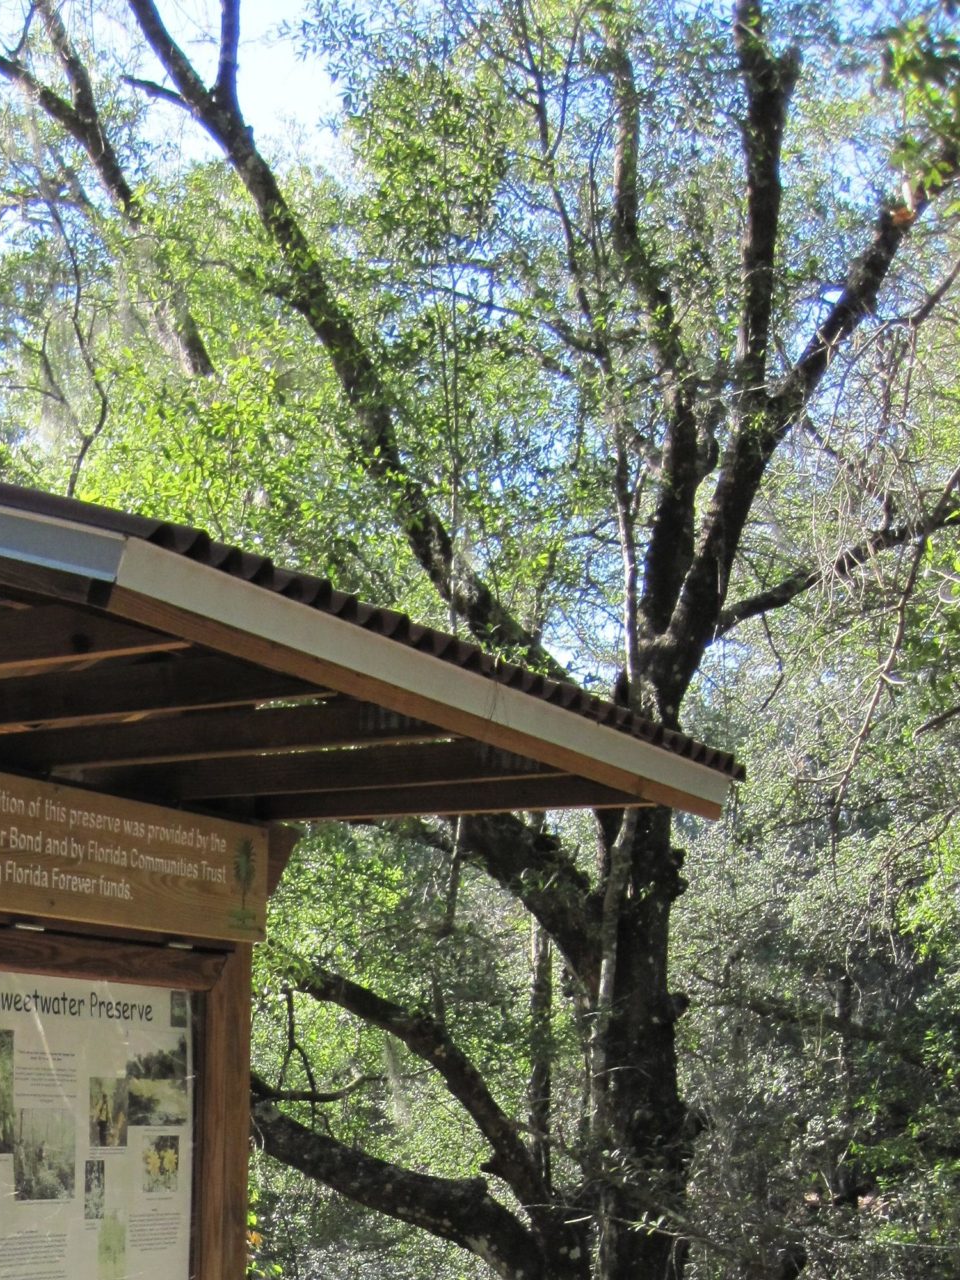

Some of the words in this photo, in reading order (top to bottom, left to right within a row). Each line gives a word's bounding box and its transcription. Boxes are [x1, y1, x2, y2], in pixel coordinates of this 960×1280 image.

[28, 796, 41, 817] of
[45, 799, 66, 823] this
[69, 808, 121, 832] preserve
[123, 818, 145, 838] was
[148, 822, 194, 844] provided
[196, 828, 209, 849] by
[210, 832, 227, 853] the
[9, 827, 42, 854] Bond
[45, 837, 68, 856] and
[70, 837, 84, 865] by
[88, 840, 127, 867] Florida
[130, 848, 198, 879] Communities
[201, 860, 227, 884] Trust
[5, 860, 48, 888] Florida
[51, 867, 97, 894] Forever
[98, 874, 133, 900] funds.
[90, 991, 154, 1022] Preserve
